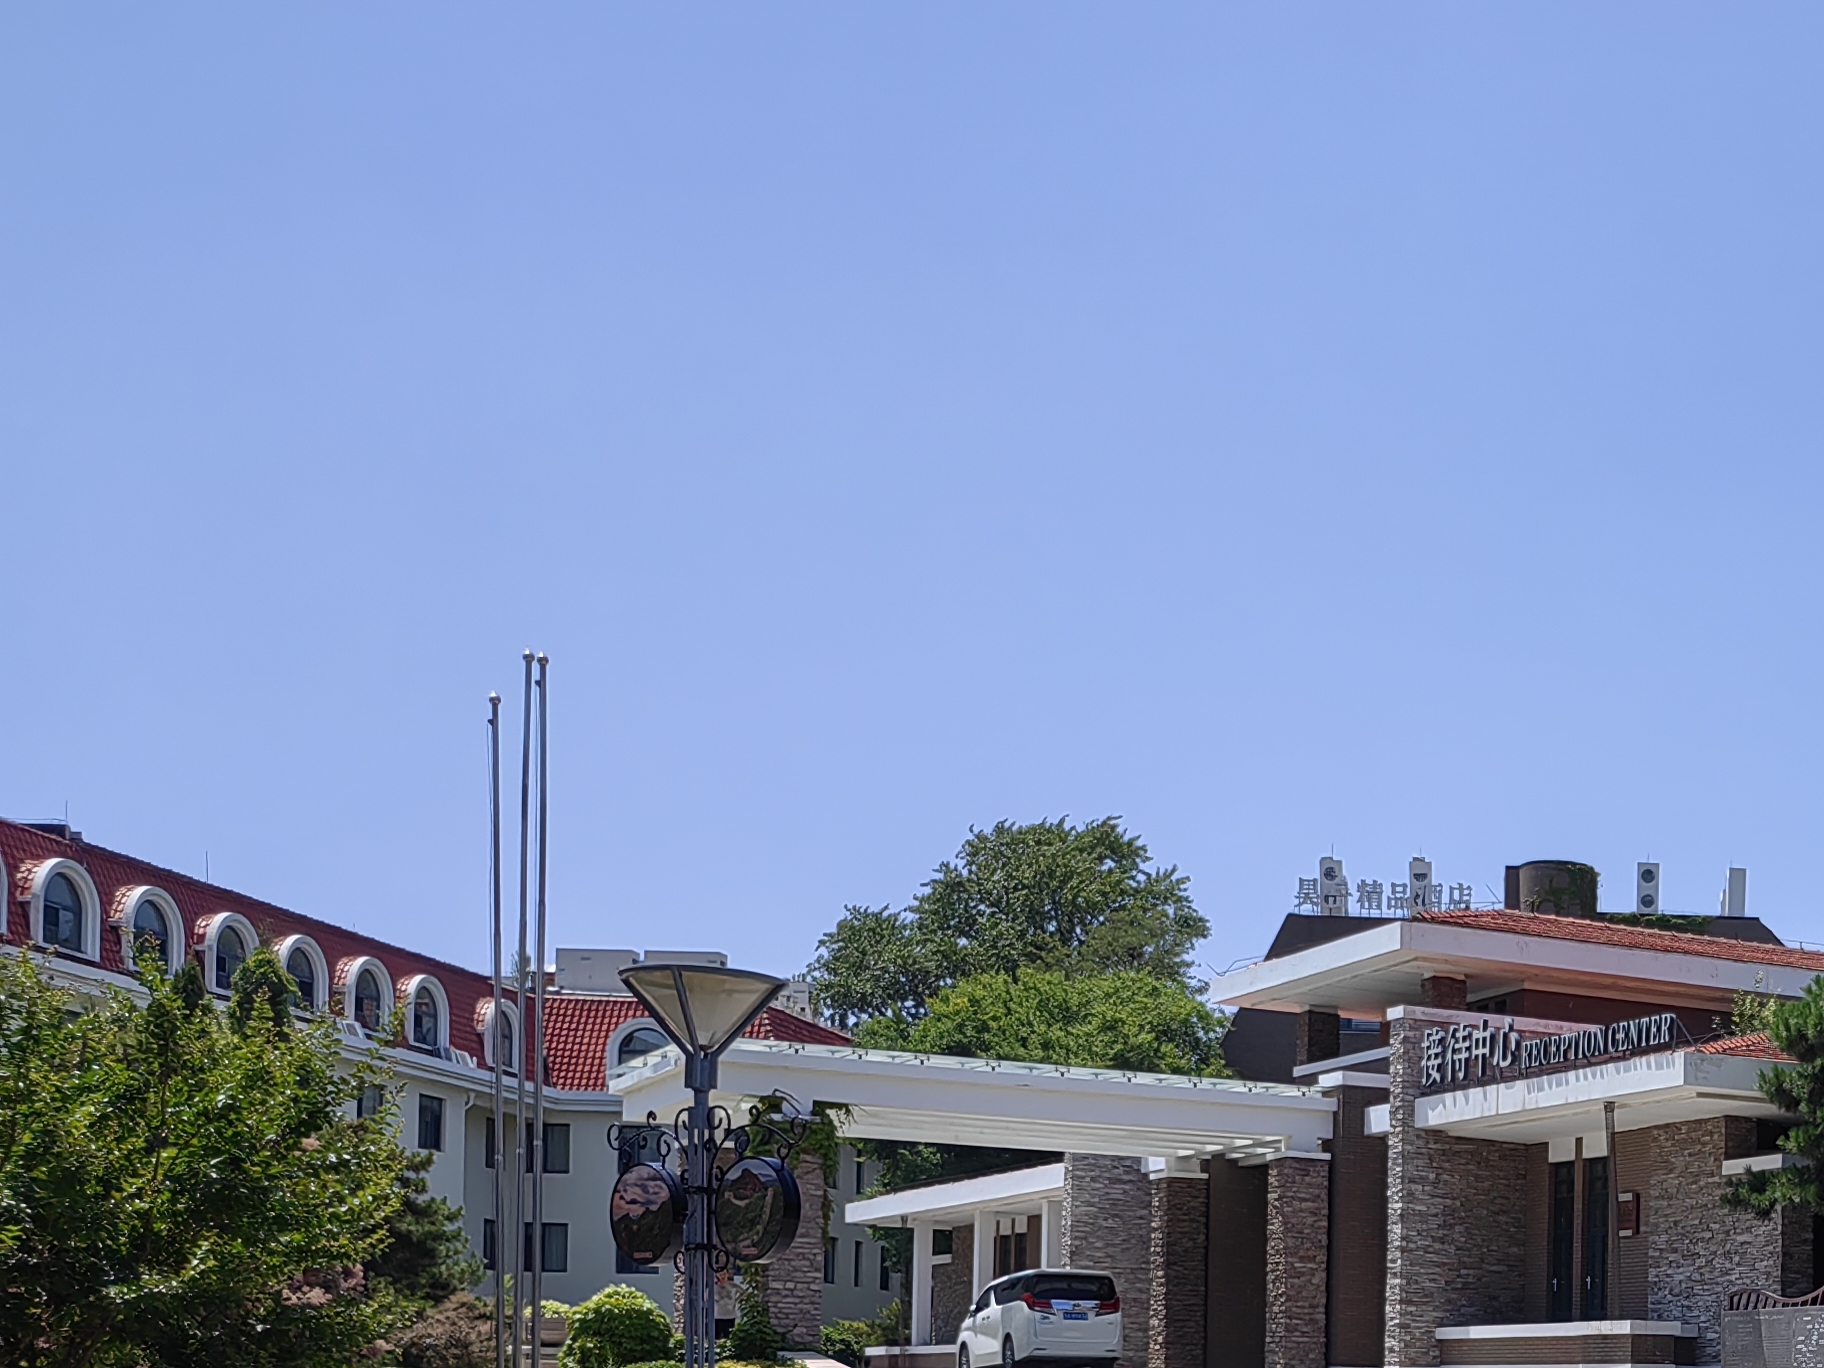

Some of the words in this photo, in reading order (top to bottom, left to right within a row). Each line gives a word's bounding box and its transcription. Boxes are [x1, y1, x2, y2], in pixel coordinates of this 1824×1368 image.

[1421, 1017, 1520, 1087] 接待中心
[1521, 1025, 1606, 1068] RECEPTION
[1607, 1013, 1676, 1053] CENTER
